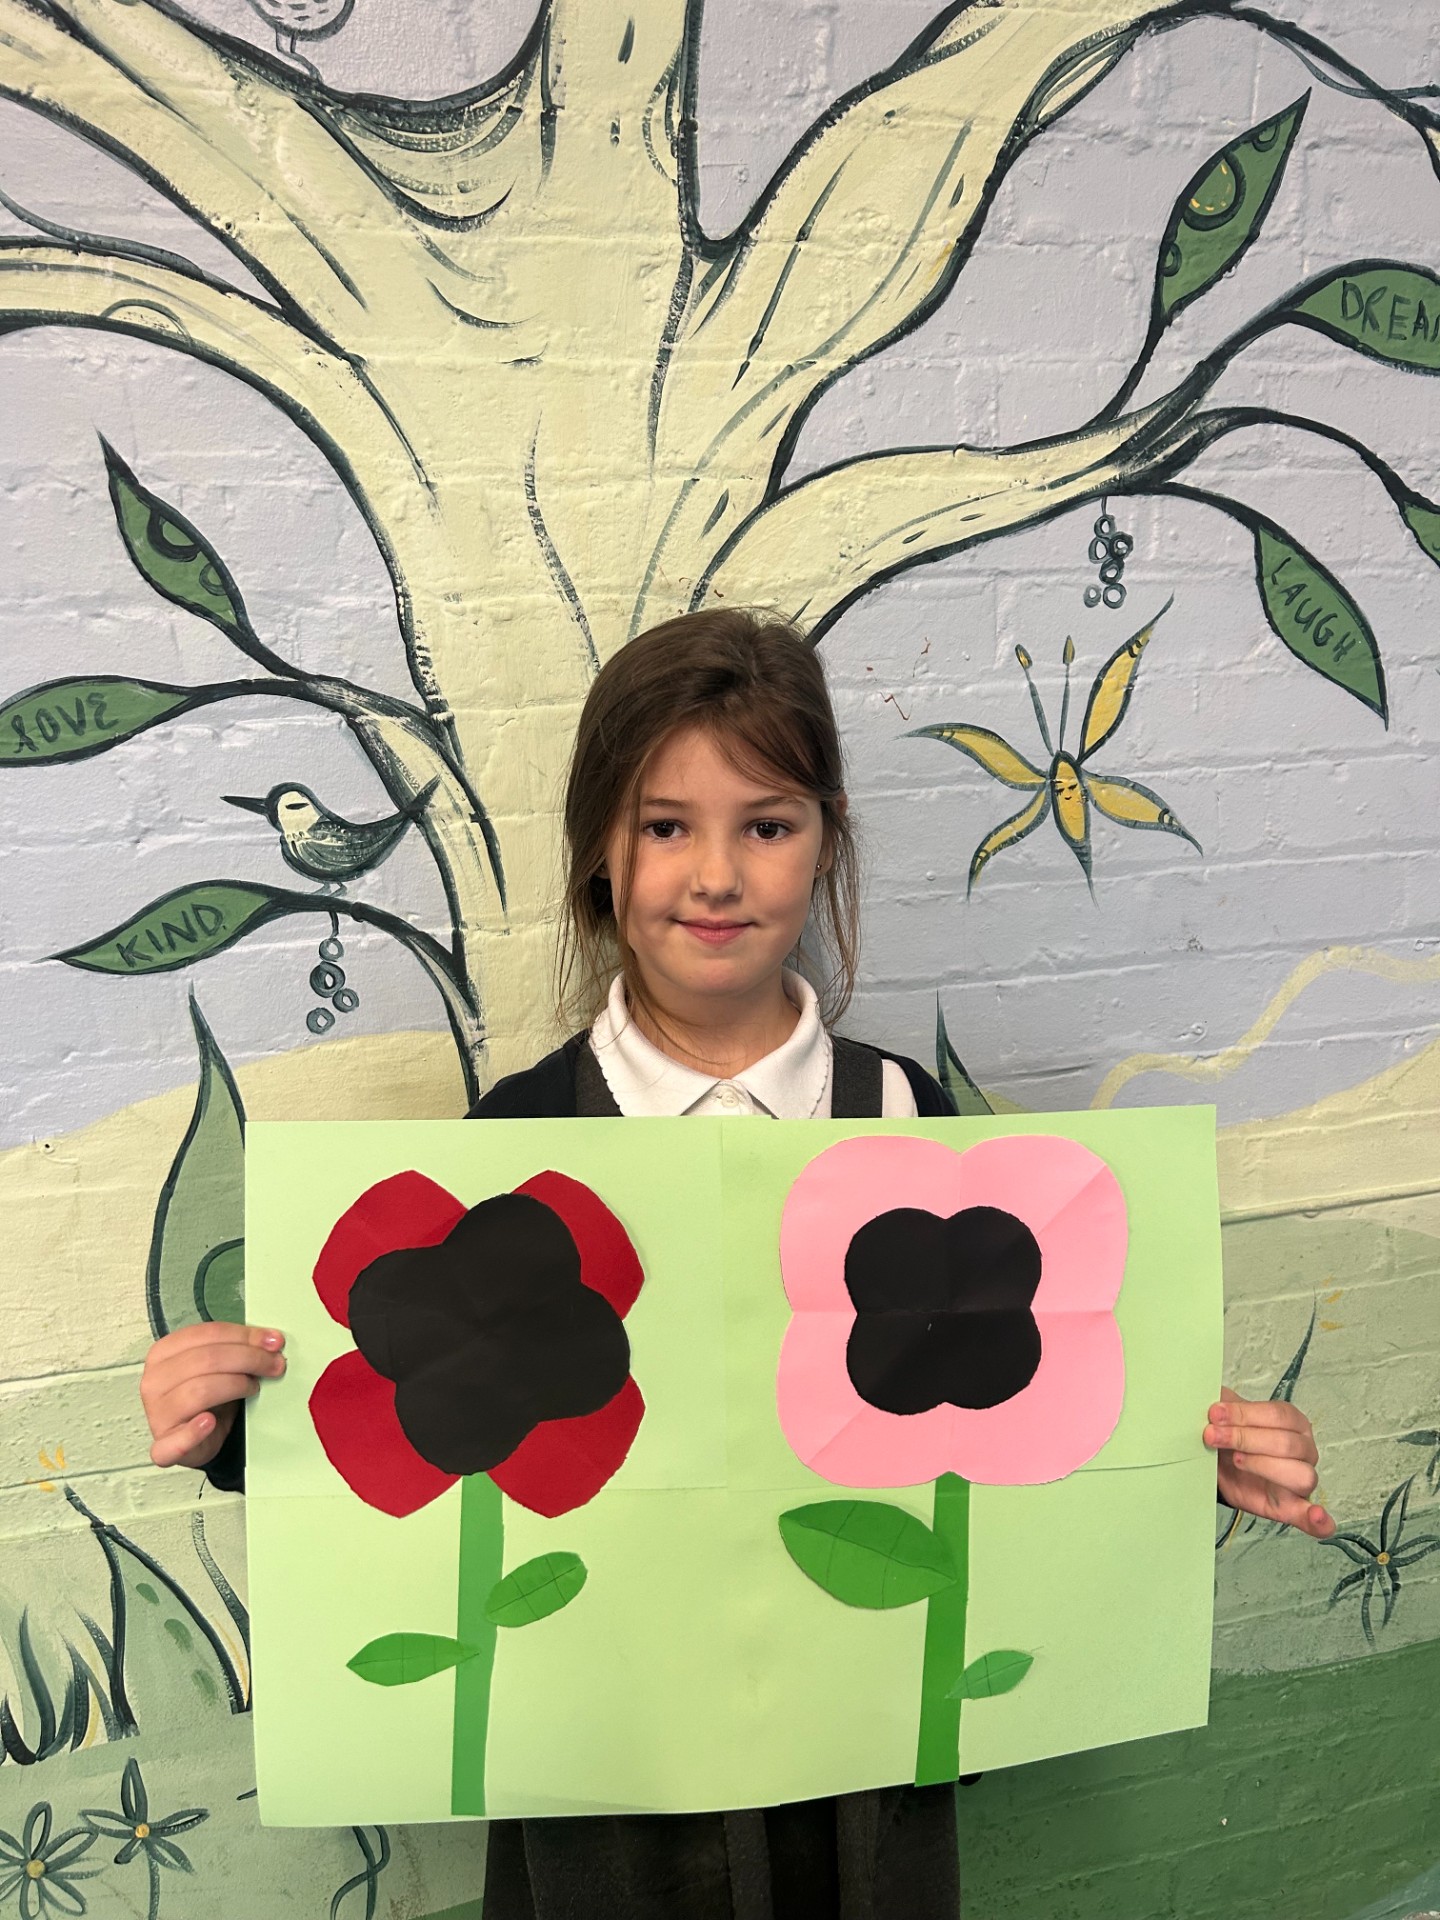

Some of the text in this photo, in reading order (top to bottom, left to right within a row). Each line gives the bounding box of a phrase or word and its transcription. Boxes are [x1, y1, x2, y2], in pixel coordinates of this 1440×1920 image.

[1341, 279, 1440, 342] DREA
[1271, 556, 1356, 663] LAUGH
[11, 692, 119, 754] LOVE
[116, 903, 225, 967] KIND
